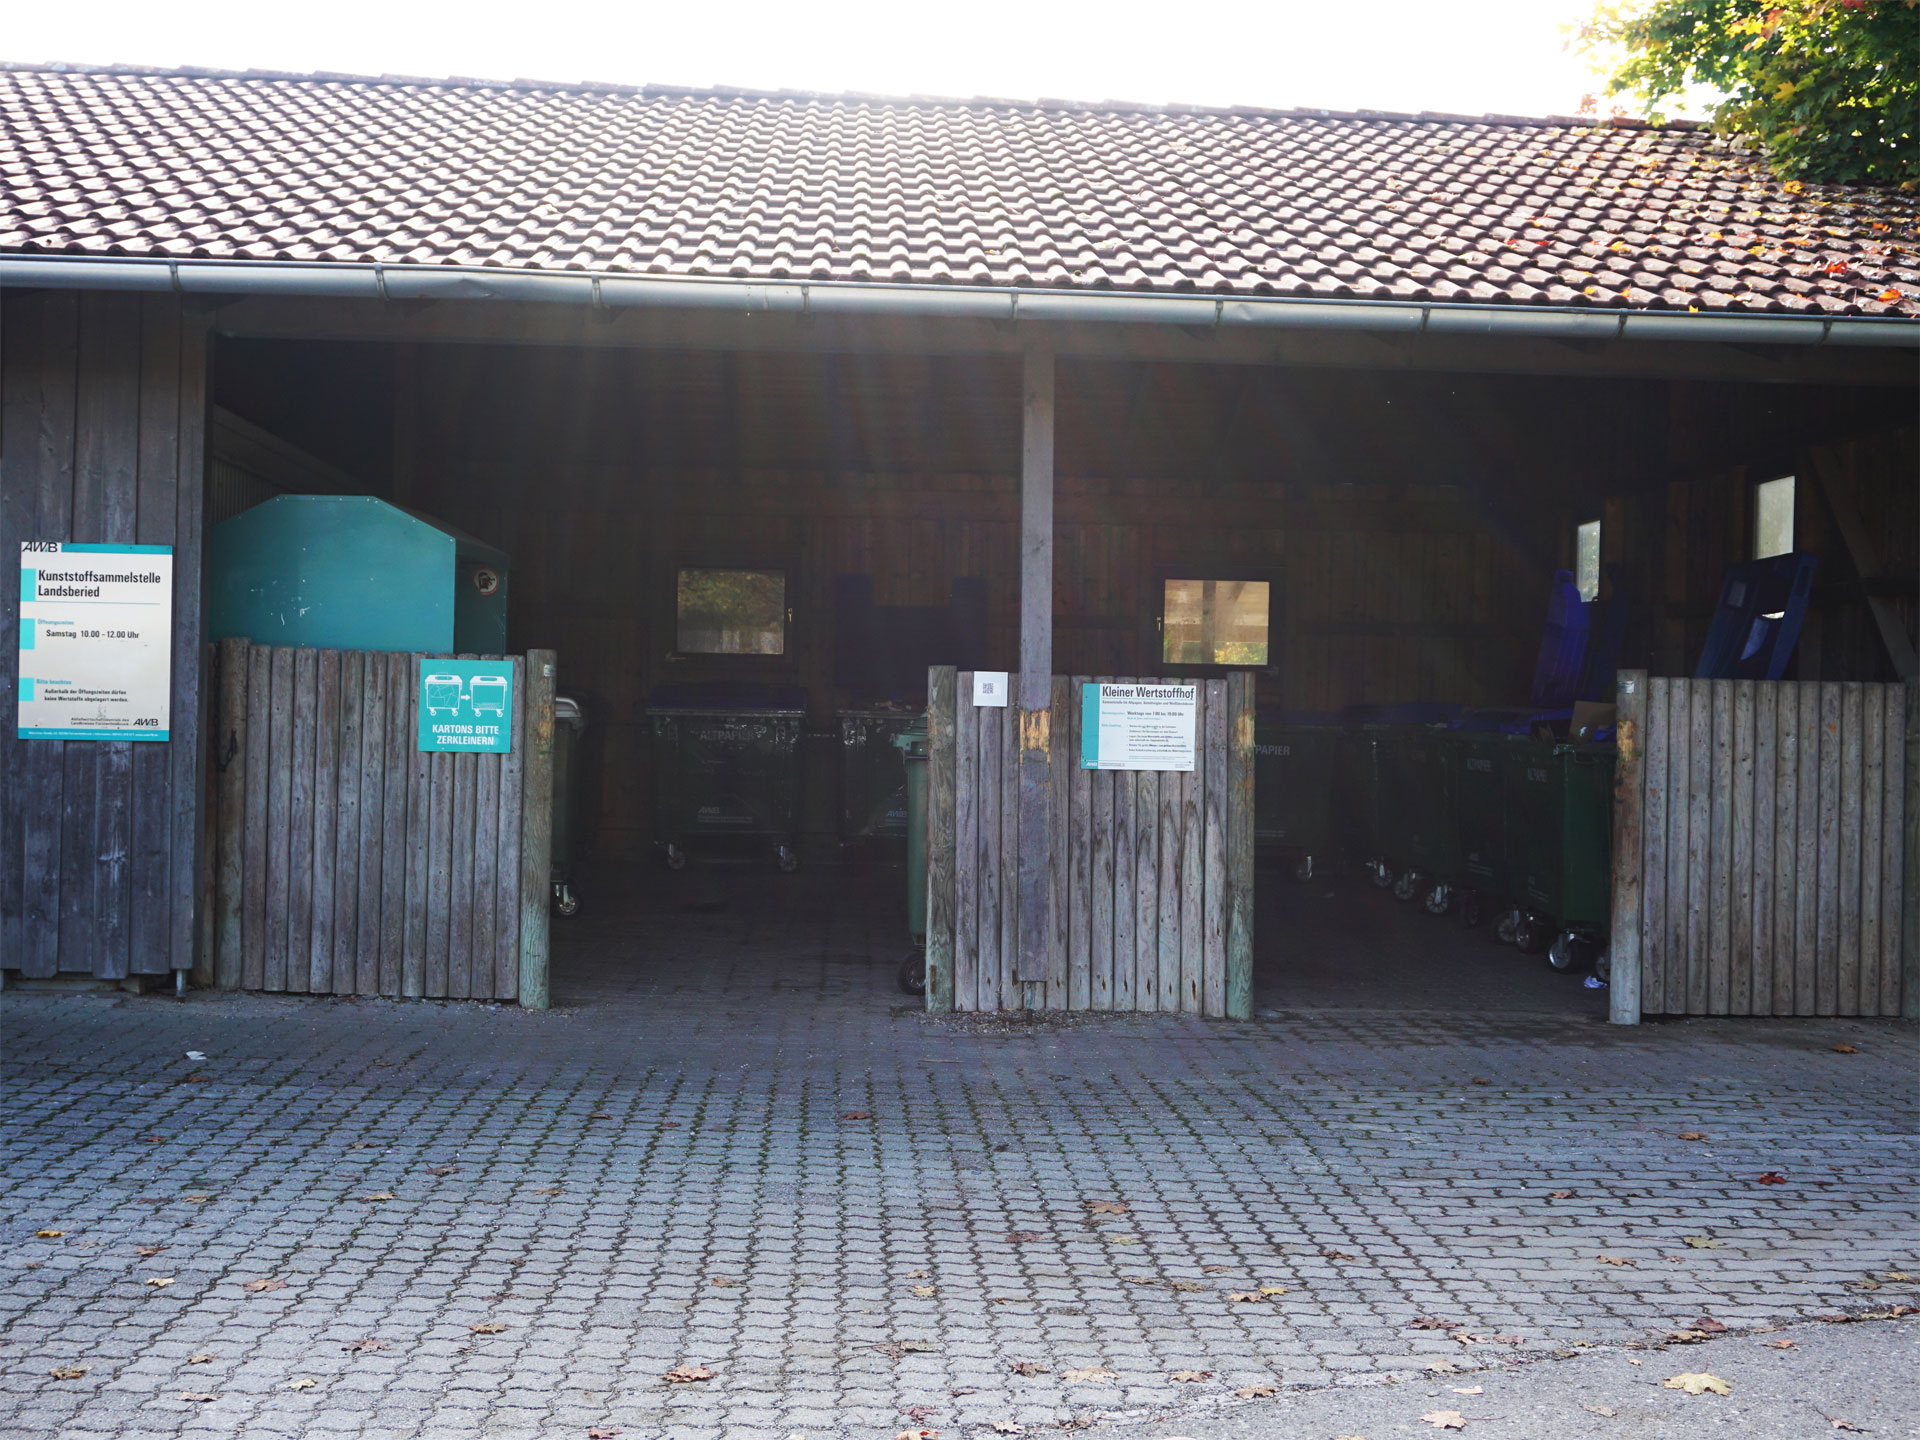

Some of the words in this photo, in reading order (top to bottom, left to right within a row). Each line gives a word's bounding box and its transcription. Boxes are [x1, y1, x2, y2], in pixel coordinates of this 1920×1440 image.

[38, 570, 161, 584] Kunststoffsammelstelle
[38, 585, 100, 598] Landsberied
[46, 629, 77, 639] Samstag
[81, 630, 99, 638] 10.00
[127, 631, 140, 639] Uhr
[1102, 686, 1134, 697] Kleiner
[1136, 687, 1195, 700] Wertstoffhof
[432, 724, 473, 734] KARTONS
[475, 725, 499, 735] BITTE
[437, 735, 494, 745] ZERKLEINERN
